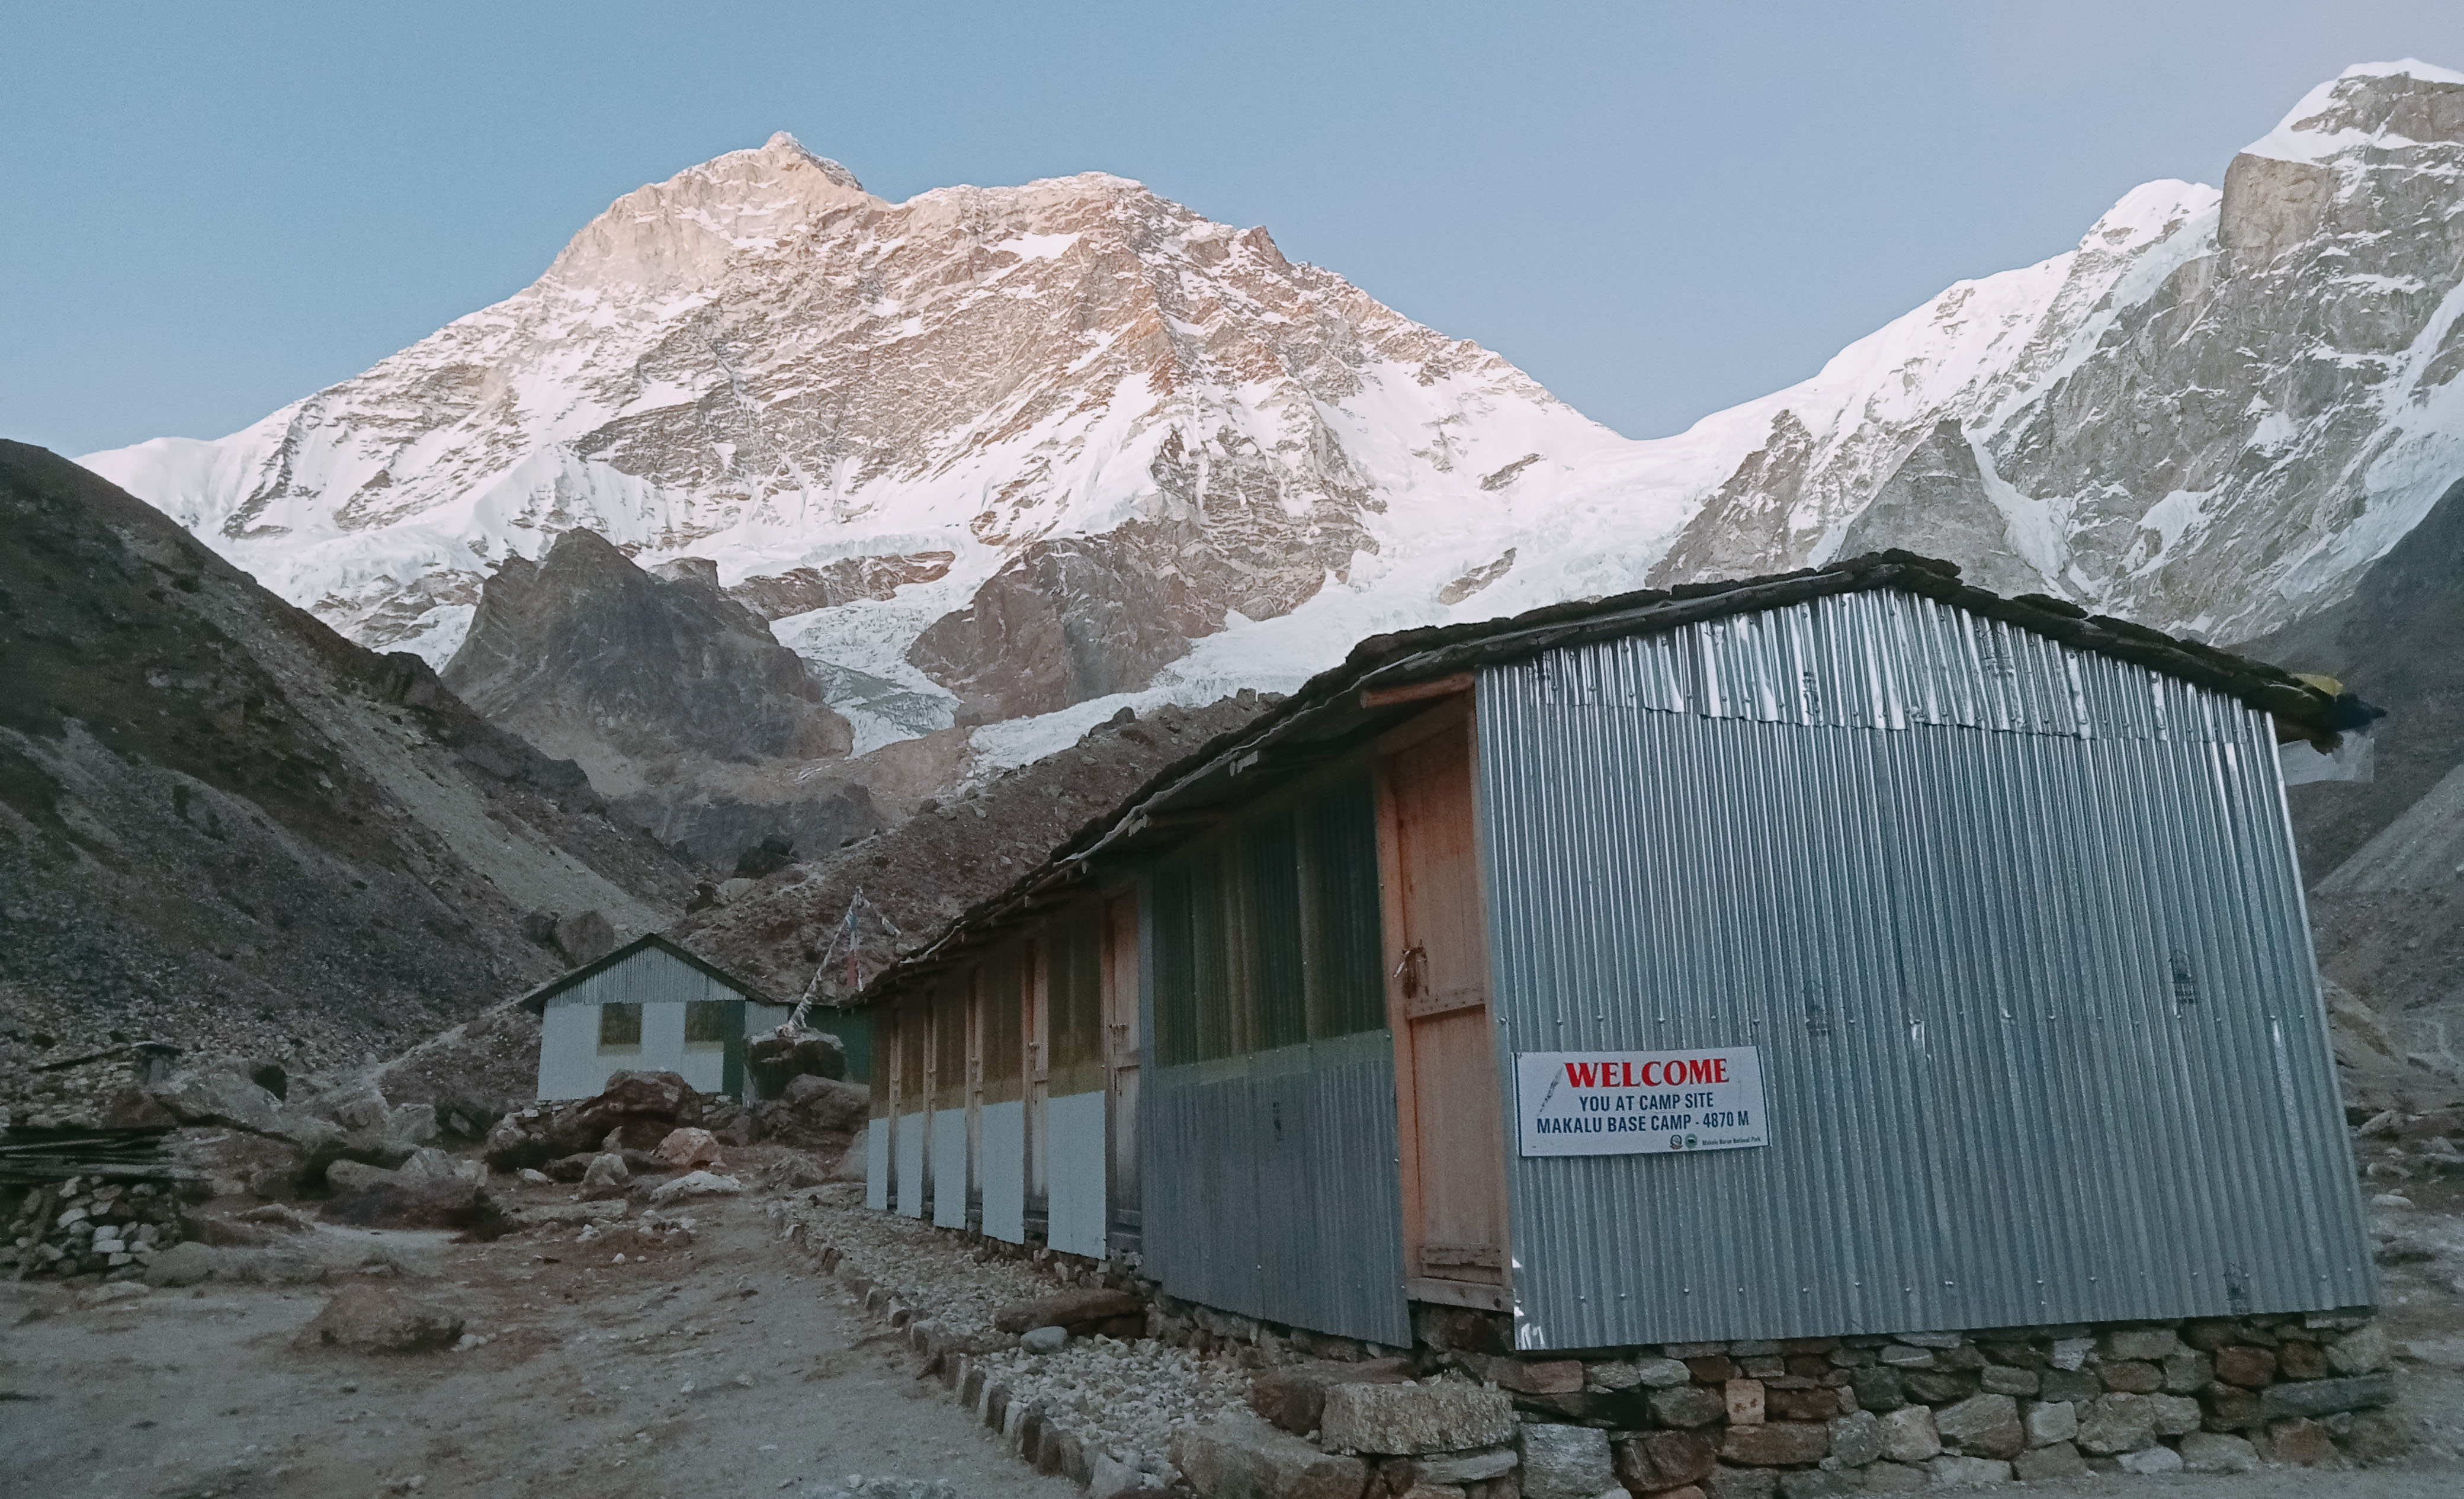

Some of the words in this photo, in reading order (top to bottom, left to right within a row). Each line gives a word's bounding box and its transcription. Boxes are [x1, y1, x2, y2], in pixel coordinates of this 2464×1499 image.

[1564, 1058, 1730, 1088] WELCOME
[1579, 1096, 1610, 1112] YOU
[1615, 1095, 1635, 1111] AT
[1639, 1094, 1680, 1110] CAMP
[1685, 1092, 1714, 1108] SITE
[1537, 1117, 1602, 1134] MAKALU
[1608, 1116, 1646, 1132] BASE
[1651, 1114, 1692, 1131] CAMP
[1702, 1111, 1734, 1128] 4870
[1737, 1110, 1749, 1126] M
